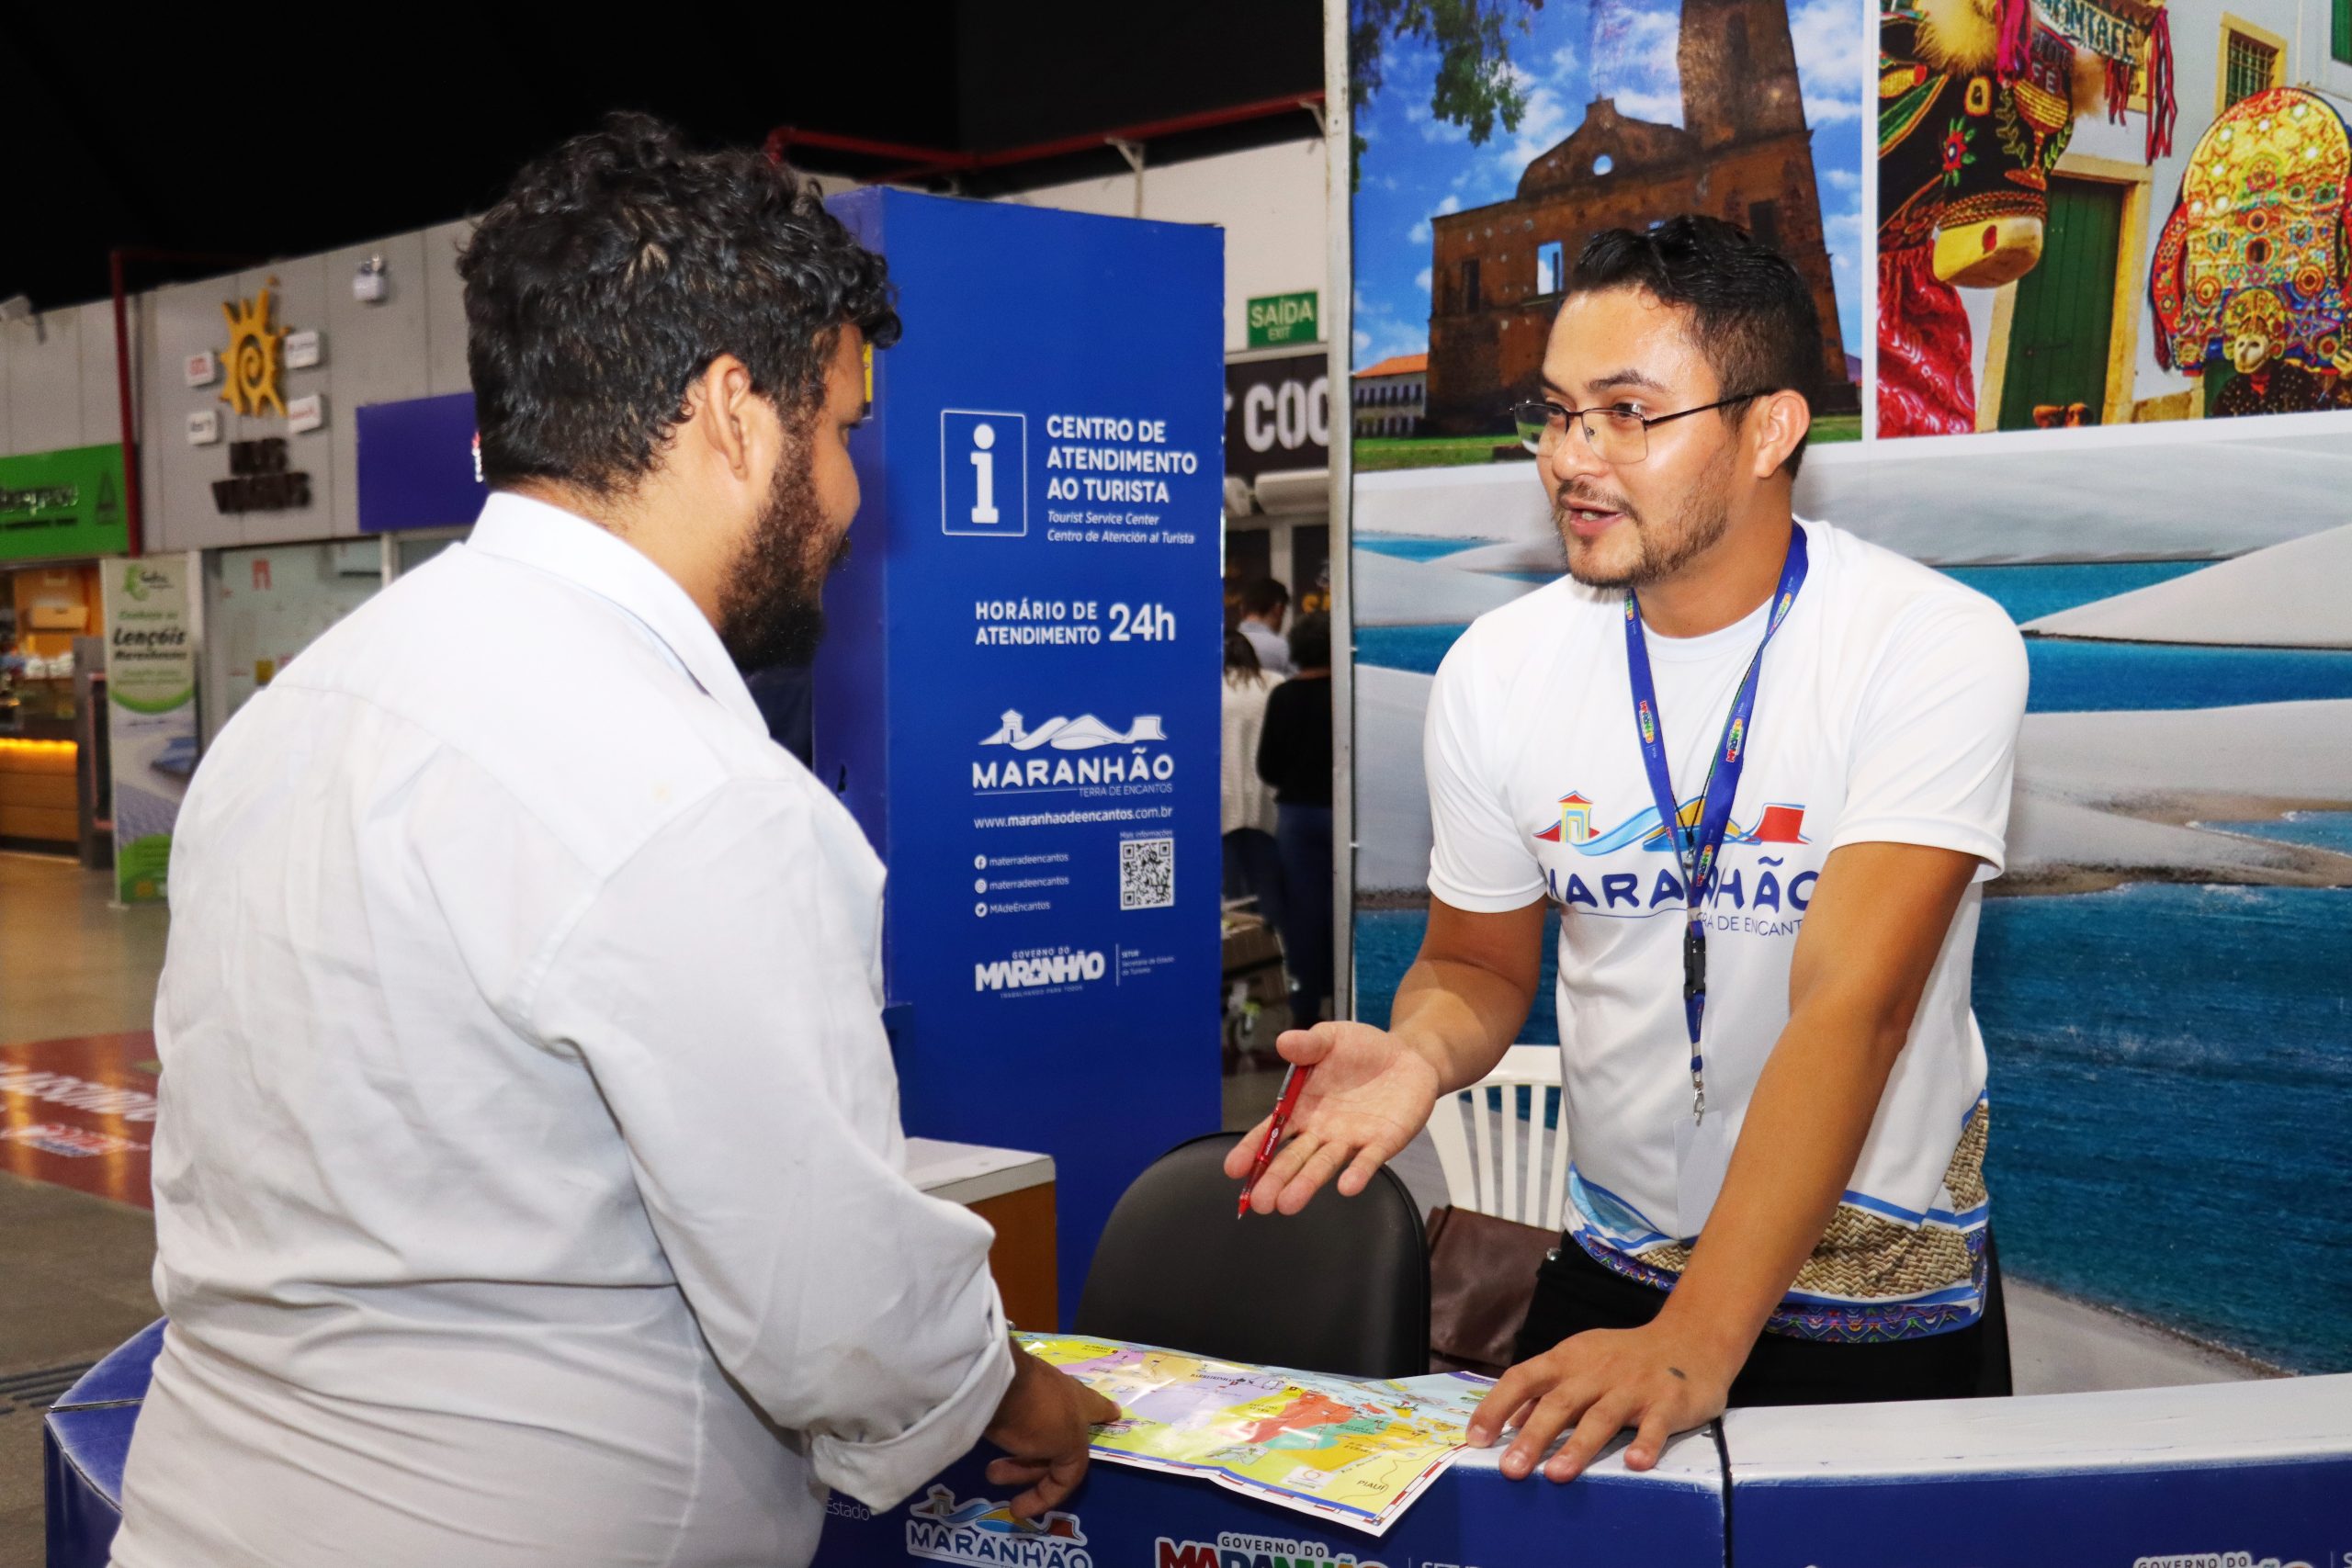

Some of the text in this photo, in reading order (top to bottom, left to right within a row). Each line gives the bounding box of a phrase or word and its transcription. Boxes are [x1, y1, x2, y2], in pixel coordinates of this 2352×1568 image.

[1250, 298, 1314, 328] SAÍDA
[1268, 326, 1291, 342] EXIT
[1046, 415, 1167, 443] CENTRO DE
[1046, 446, 1198, 475] ATENDIMENTO
[1046, 478, 1170, 503] AO TURISTA
[1047, 511, 1160, 526] Tourist Service Center
[1047, 530, 1195, 545] Centro de Atención al Turista
[975, 598, 1098, 621] HORÁRIO DE
[1109, 603, 1176, 642] 24h
[975, 626, 1102, 646] ATENDIMENTO
[972, 747, 1174, 789] MARANHÃO
[1080, 784, 1173, 798] TERRA DE ENCANTOS
[974, 807, 1173, 829] www.maranhaodeencantos.com.br
[989, 853, 1069, 867] materradeencantos
[989, 875, 1069, 890] materradeencantos
[989, 901, 1051, 915] MAdeEncantos
[1717, 915, 1740, 931] DE
[1745, 917, 1803, 937] ENCANT
[1012, 946, 1070, 960] GOVERNO DO
[975, 951, 1105, 992] MARANHÃO
[827, 1496, 870, 1521] Estado
[1221, 1534, 1296, 1556] GOVERNO
[1304, 1545, 1325, 1559] DO
